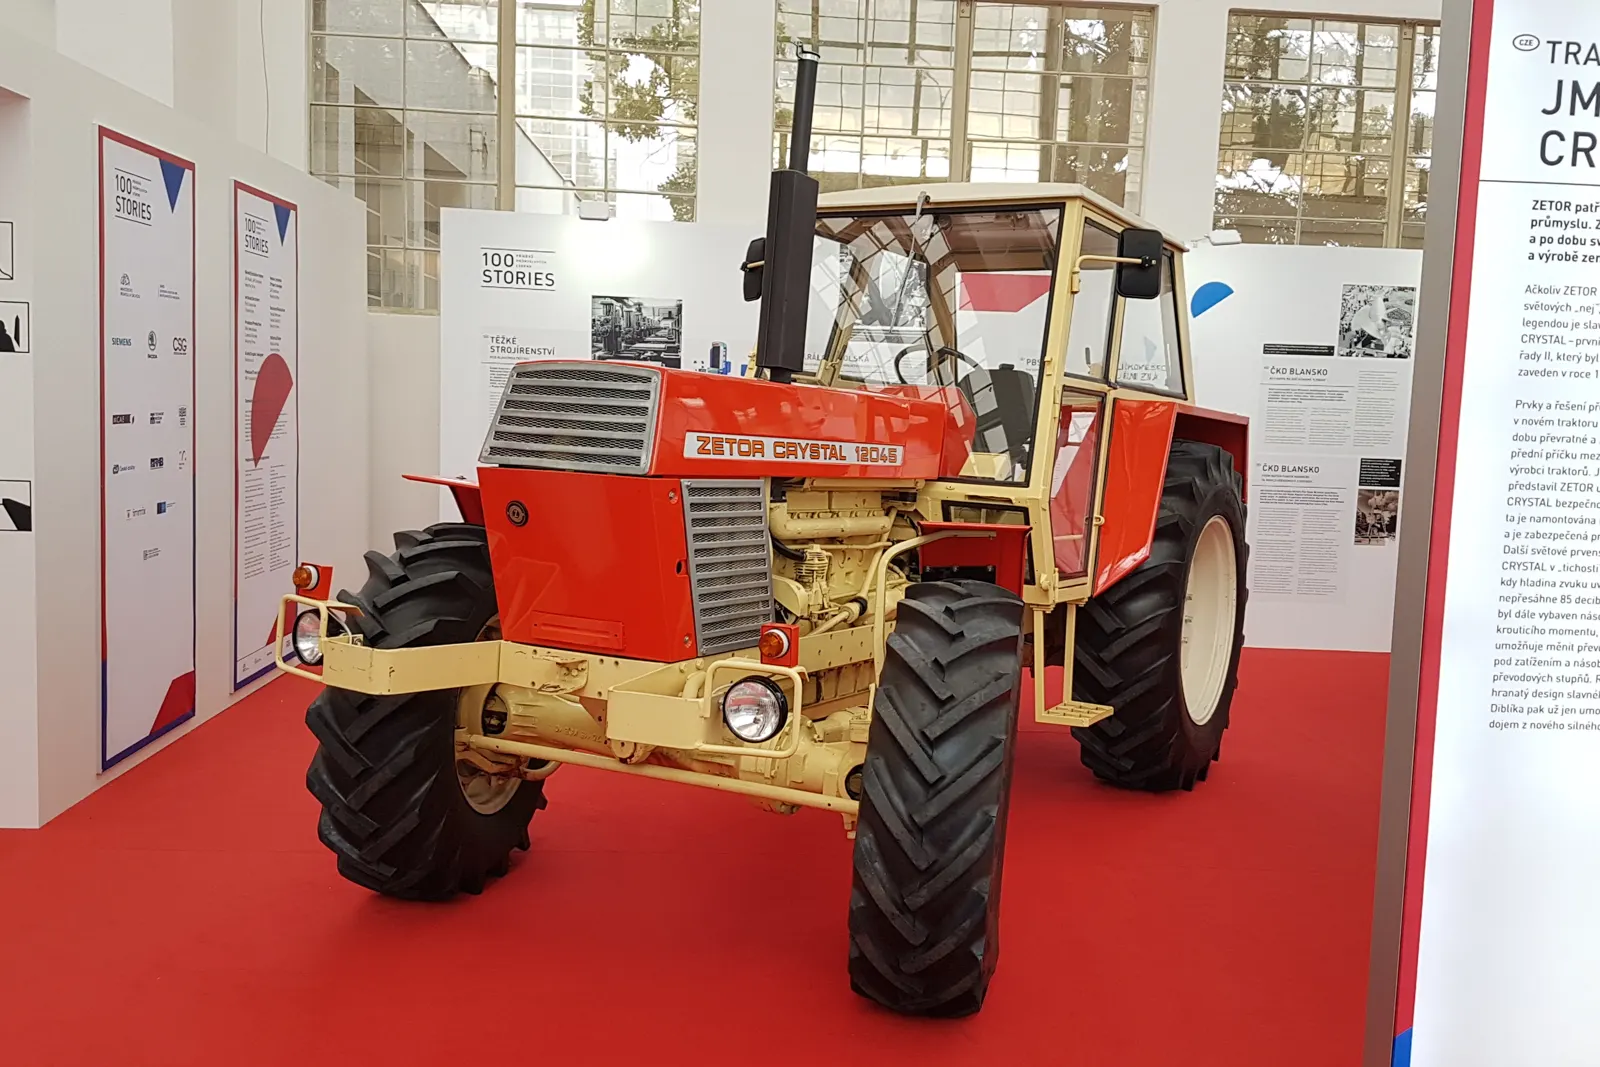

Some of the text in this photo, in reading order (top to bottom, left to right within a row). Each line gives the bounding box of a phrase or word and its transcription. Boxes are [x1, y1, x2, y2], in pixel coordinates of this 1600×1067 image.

[1546, 41, 1600, 66] TRA
[1541, 79, 1600, 117] JM
[1540, 130, 1597, 168] CR
[116, 174, 131, 194] 100
[116, 196, 151, 220] STORIES
[1532, 199, 1571, 211] ZETOR
[245, 218, 255, 233] 100
[1531, 215, 1592, 230] průmyslu.
[245, 234, 268, 253] STORIES
[1540, 236, 1554, 246] po
[1557, 234, 1586, 245] dobu
[482, 253, 514, 267] 100
[1528, 252, 1534, 260] a
[1538, 249, 1578, 263] výrobě
[483, 269, 554, 287] STORIES
[1525, 284, 1598, 296] Ačkoliv ZETOR
[1524, 301, 1571, 313] světových
[1523, 317, 1568, 330] legendou
[1570, 319, 1580, 331] je
[112, 337, 132, 346] SIEMENS
[172, 337, 187, 352] CSG
[1521, 334, 1566, 344] CRYSTAL
[490, 346, 555, 355] STROJÍRENSTVÍ
[1520, 350, 1541, 362] řady
[1557, 352, 1582, 363] který
[1585, 353, 1598, 364] byl
[1270, 366, 1287, 374] ČKD
[1518, 368, 1558, 377] zaveden
[1515, 400, 1543, 411] Prvky
[1555, 401, 1586, 410] řešení
[1522, 416, 1554, 426] novém
[1558, 418, 1598, 428] traktoru
[1512, 433, 1536, 442] dobu
[1540, 433, 1587, 444] převratné
[696, 435, 897, 463] ZETOR CRYSTAL 12045
[1511, 448, 1543, 459] přední
[1546, 449, 1577, 460] příčku
[1262, 463, 1320, 473] ČKD BLANSKO
[1510, 465, 1544, 476] výrobci
[1548, 466, 1591, 476] traktorů.
[1508, 481, 1557, 492] představil
[1560, 482, 1594, 492] ZETOR
[1507, 497, 1552, 507] CRYSTAL
[1506, 513, 1596, 524] ta je namontována
[1512, 529, 1521, 540] je
[1525, 530, 1588, 541] zabezpečená
[1504, 545, 1528, 555] Další
[1531, 546, 1567, 555] světové
[1502, 561, 1547, 571] CRYSTAL
[1501, 577, 1517, 588] kdy
[1520, 578, 1556, 587] hladina
[1559, 580, 1587, 588] zvuku
[1499, 593, 1557, 604] nepřesáhne
[1560, 594, 1572, 604] 85
[1498, 609, 1511, 620] byl
[1515, 610, 1535, 619] dále
[1539, 611, 1577, 621] vybaven
[1549, 628, 1598, 637] momentu,
[1496, 641, 1543, 652] umožňuje
[1546, 642, 1574, 651] měnit
[1494, 657, 1512, 667] pod
[1515, 657, 1561, 666] zatížením
[1493, 672, 1553, 684] převodových
[1556, 674, 1592, 685] stupňů.
[1492, 688, 1529, 699] hranatý
[1532, 689, 1564, 700] design
[1491, 704, 1524, 713] Diblíka
[1527, 705, 1544, 715] pak
[1548, 705, 1558, 714] už
[1561, 705, 1576, 716] jen
[1489, 720, 1519, 730] dojem
[1530, 720, 1564, 730] nového
